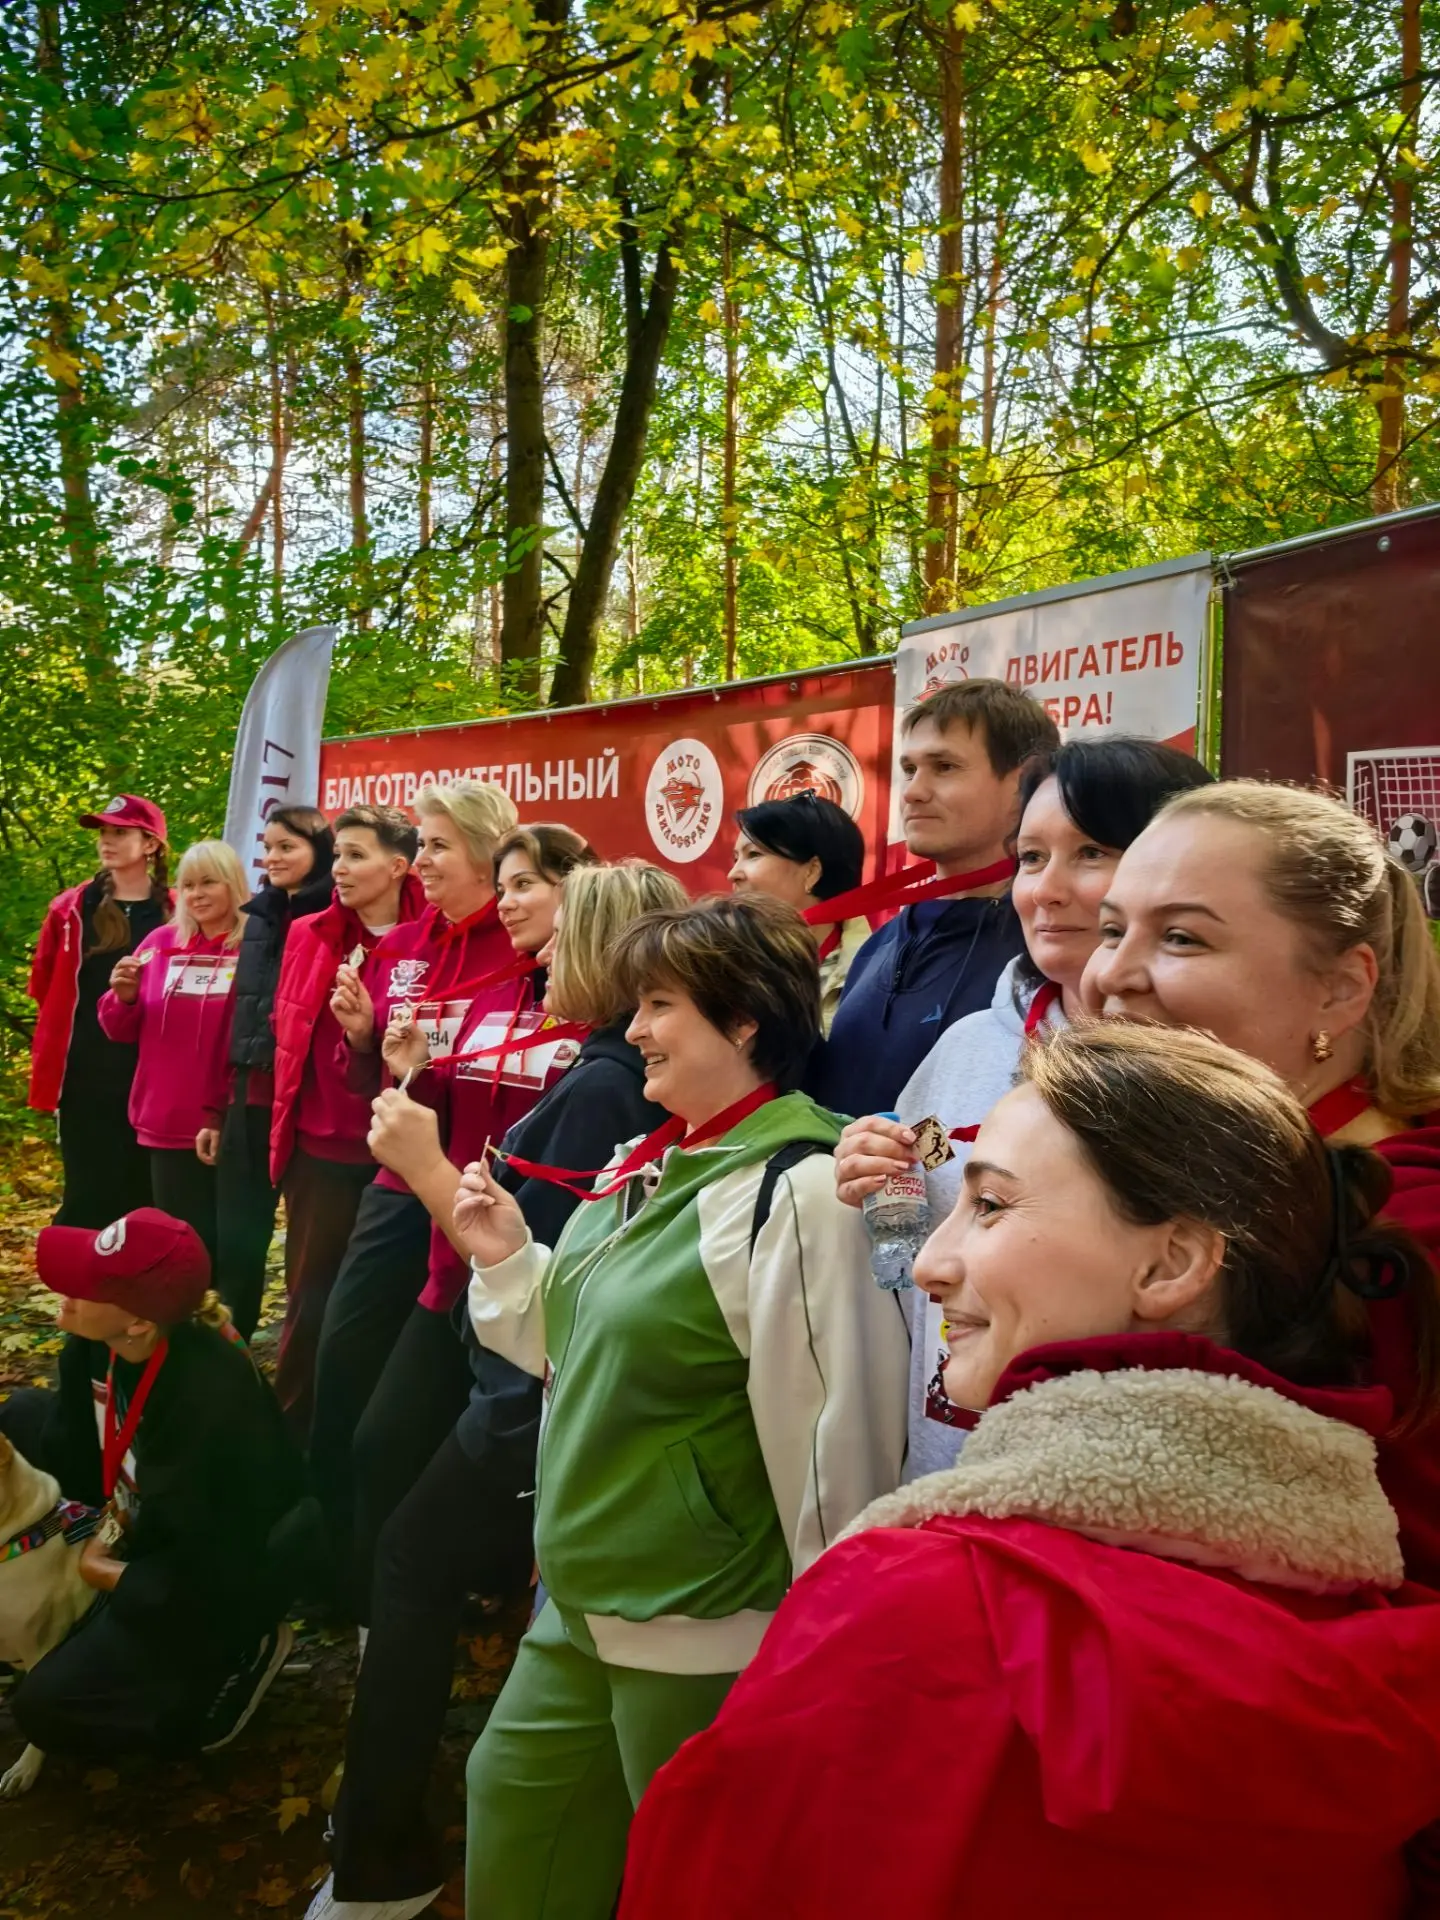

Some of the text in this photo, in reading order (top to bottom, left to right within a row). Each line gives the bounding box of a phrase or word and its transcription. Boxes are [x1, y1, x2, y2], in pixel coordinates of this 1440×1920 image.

[926, 643, 969, 675] МОТО
[1006, 631, 1184, 688] ДВИГАТЕЛЬ
[1043, 691, 1113, 728] БРА!
[666, 754, 700, 775] МОТО
